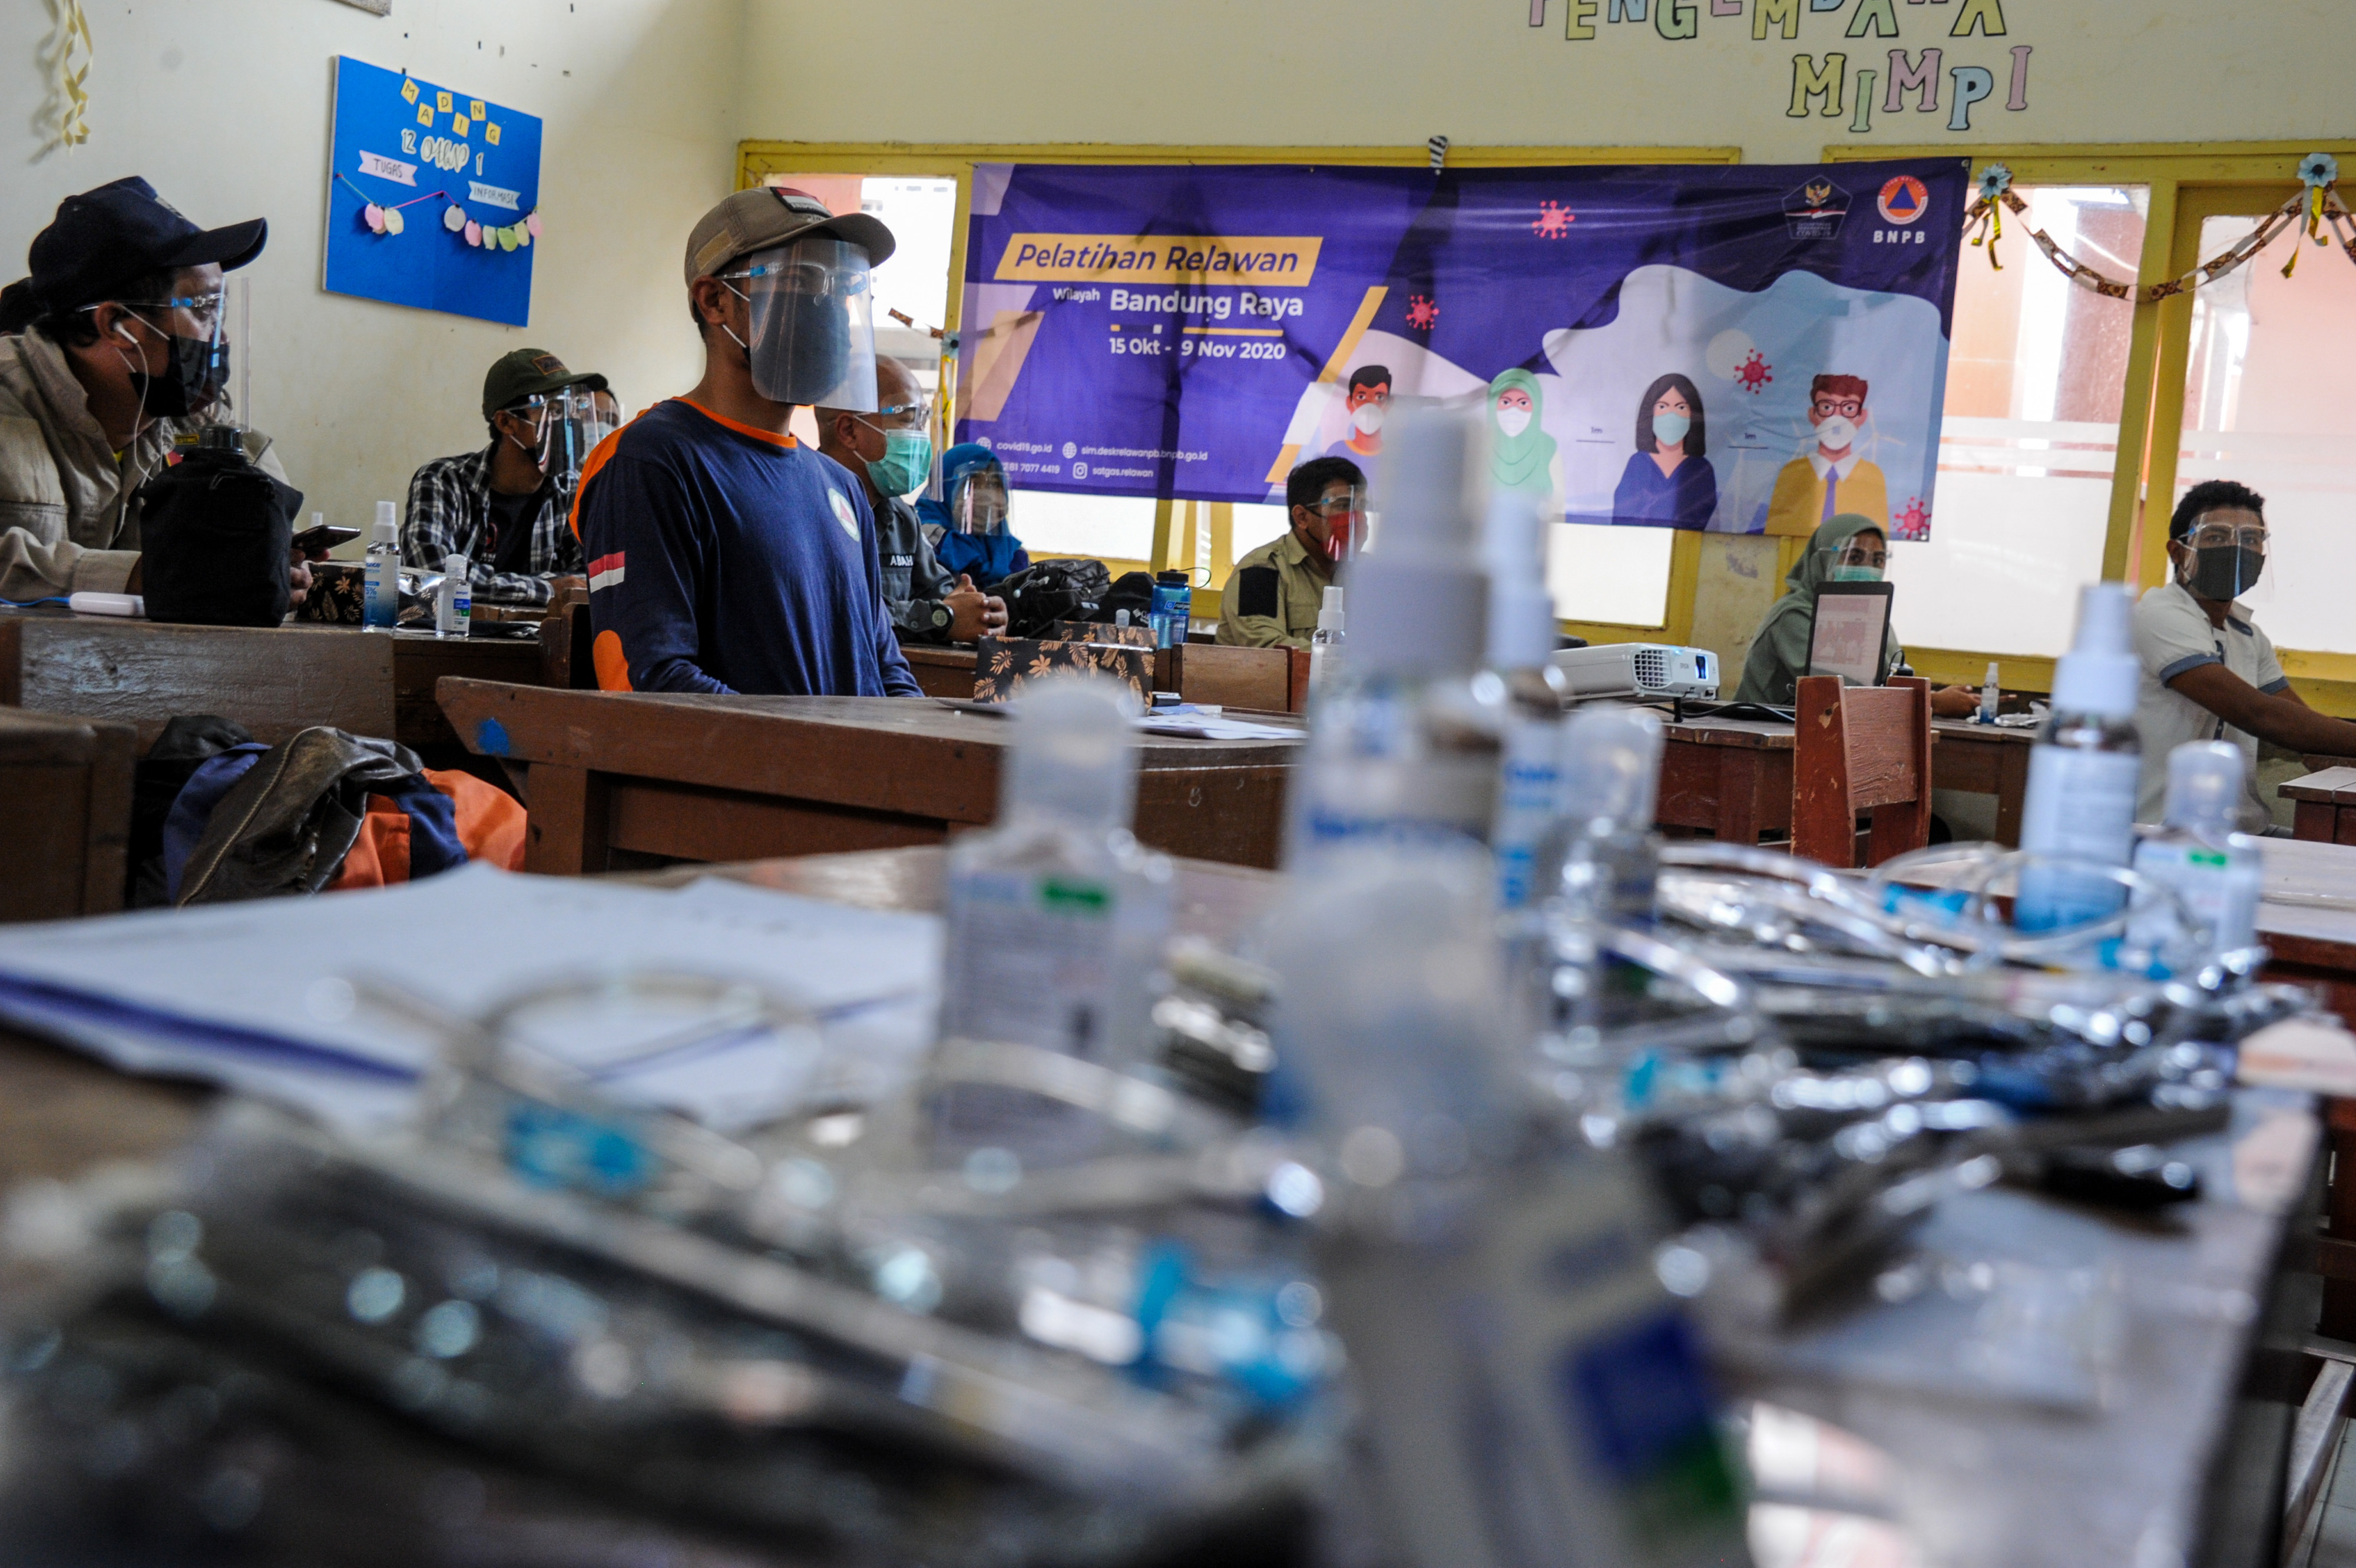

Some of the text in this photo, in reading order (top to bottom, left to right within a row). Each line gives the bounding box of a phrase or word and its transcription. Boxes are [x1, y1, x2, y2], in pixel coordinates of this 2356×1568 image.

[1786, 45, 2033, 133] MIMPI
[403, 131, 415, 152] 12
[373, 158, 403, 178] TUGAS
[474, 186, 514, 205] INFORMASI
[1873, 230, 1925, 244] BNPB
[1015, 243, 1298, 273] Pelatihan Relawan
[1053, 288, 1303, 320] Wilayah Bandung Raya
[1109, 338, 1126, 355] 15
[1129, 338, 1160, 356] Okt
[1181, 340, 1194, 357] 9
[1198, 341, 1236, 359] Nov
[1240, 342, 1287, 360] 2020
[997, 442, 1053, 454] covid19.go.id
[1020, 463, 1040, 473] 7077
[1093, 467, 1154, 478] satgas.relawan
